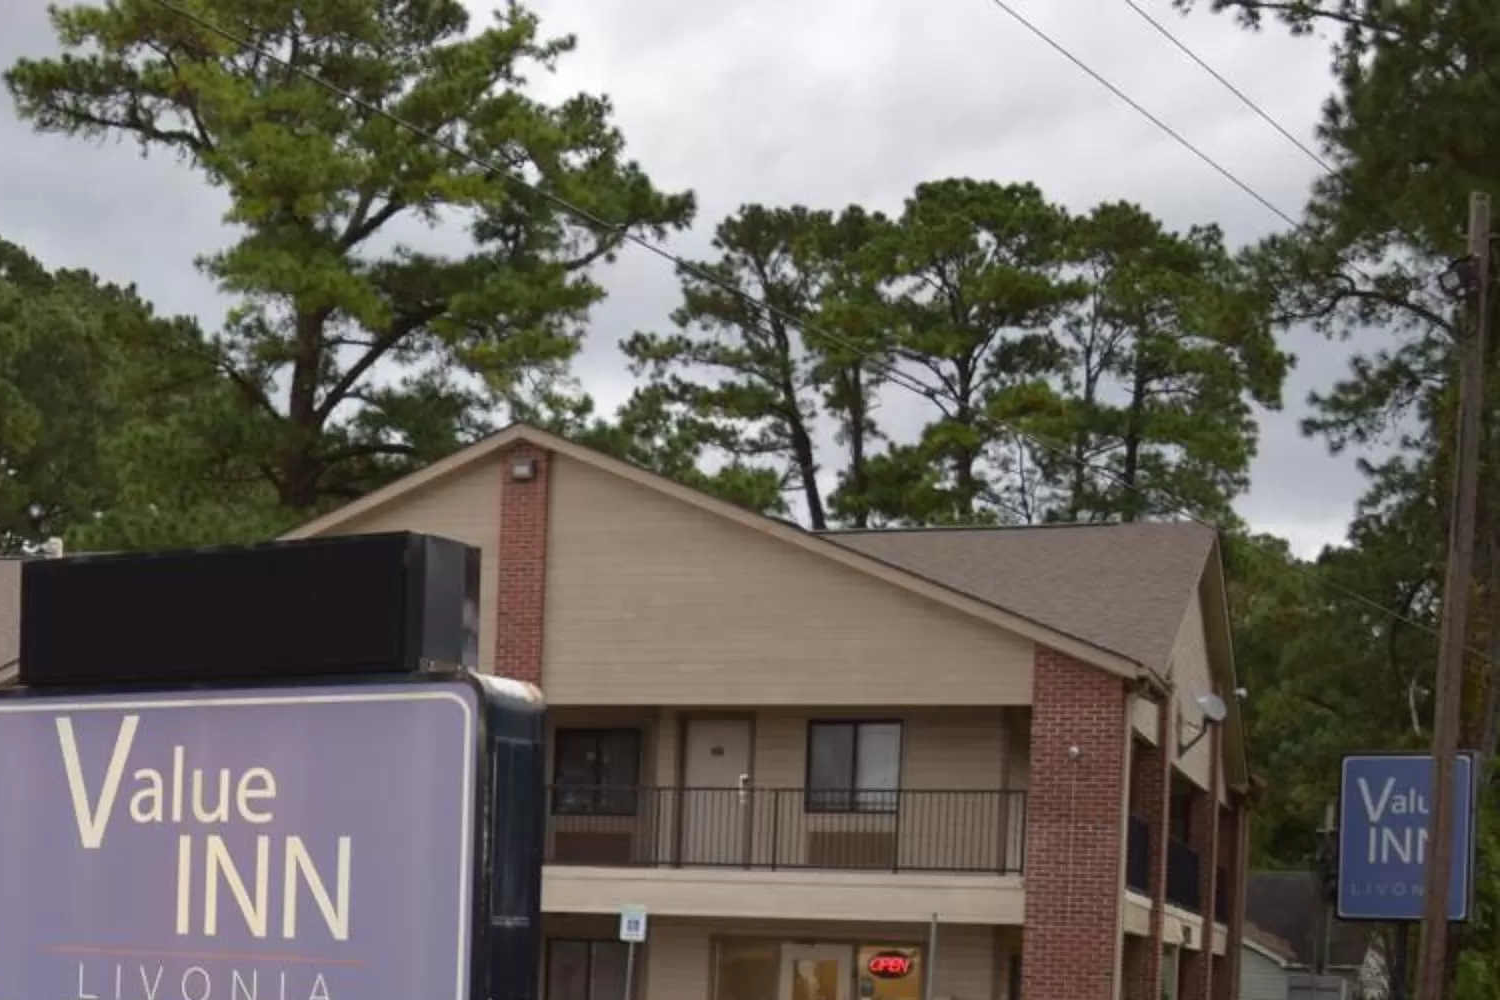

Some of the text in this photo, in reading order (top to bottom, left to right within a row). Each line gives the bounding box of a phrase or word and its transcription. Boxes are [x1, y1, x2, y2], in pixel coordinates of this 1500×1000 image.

[55, 715, 277, 849] Value
[1357, 776, 1429, 823] Valu
[175, 834, 352, 941] INN
[870, 956, 909, 974] OPEN
